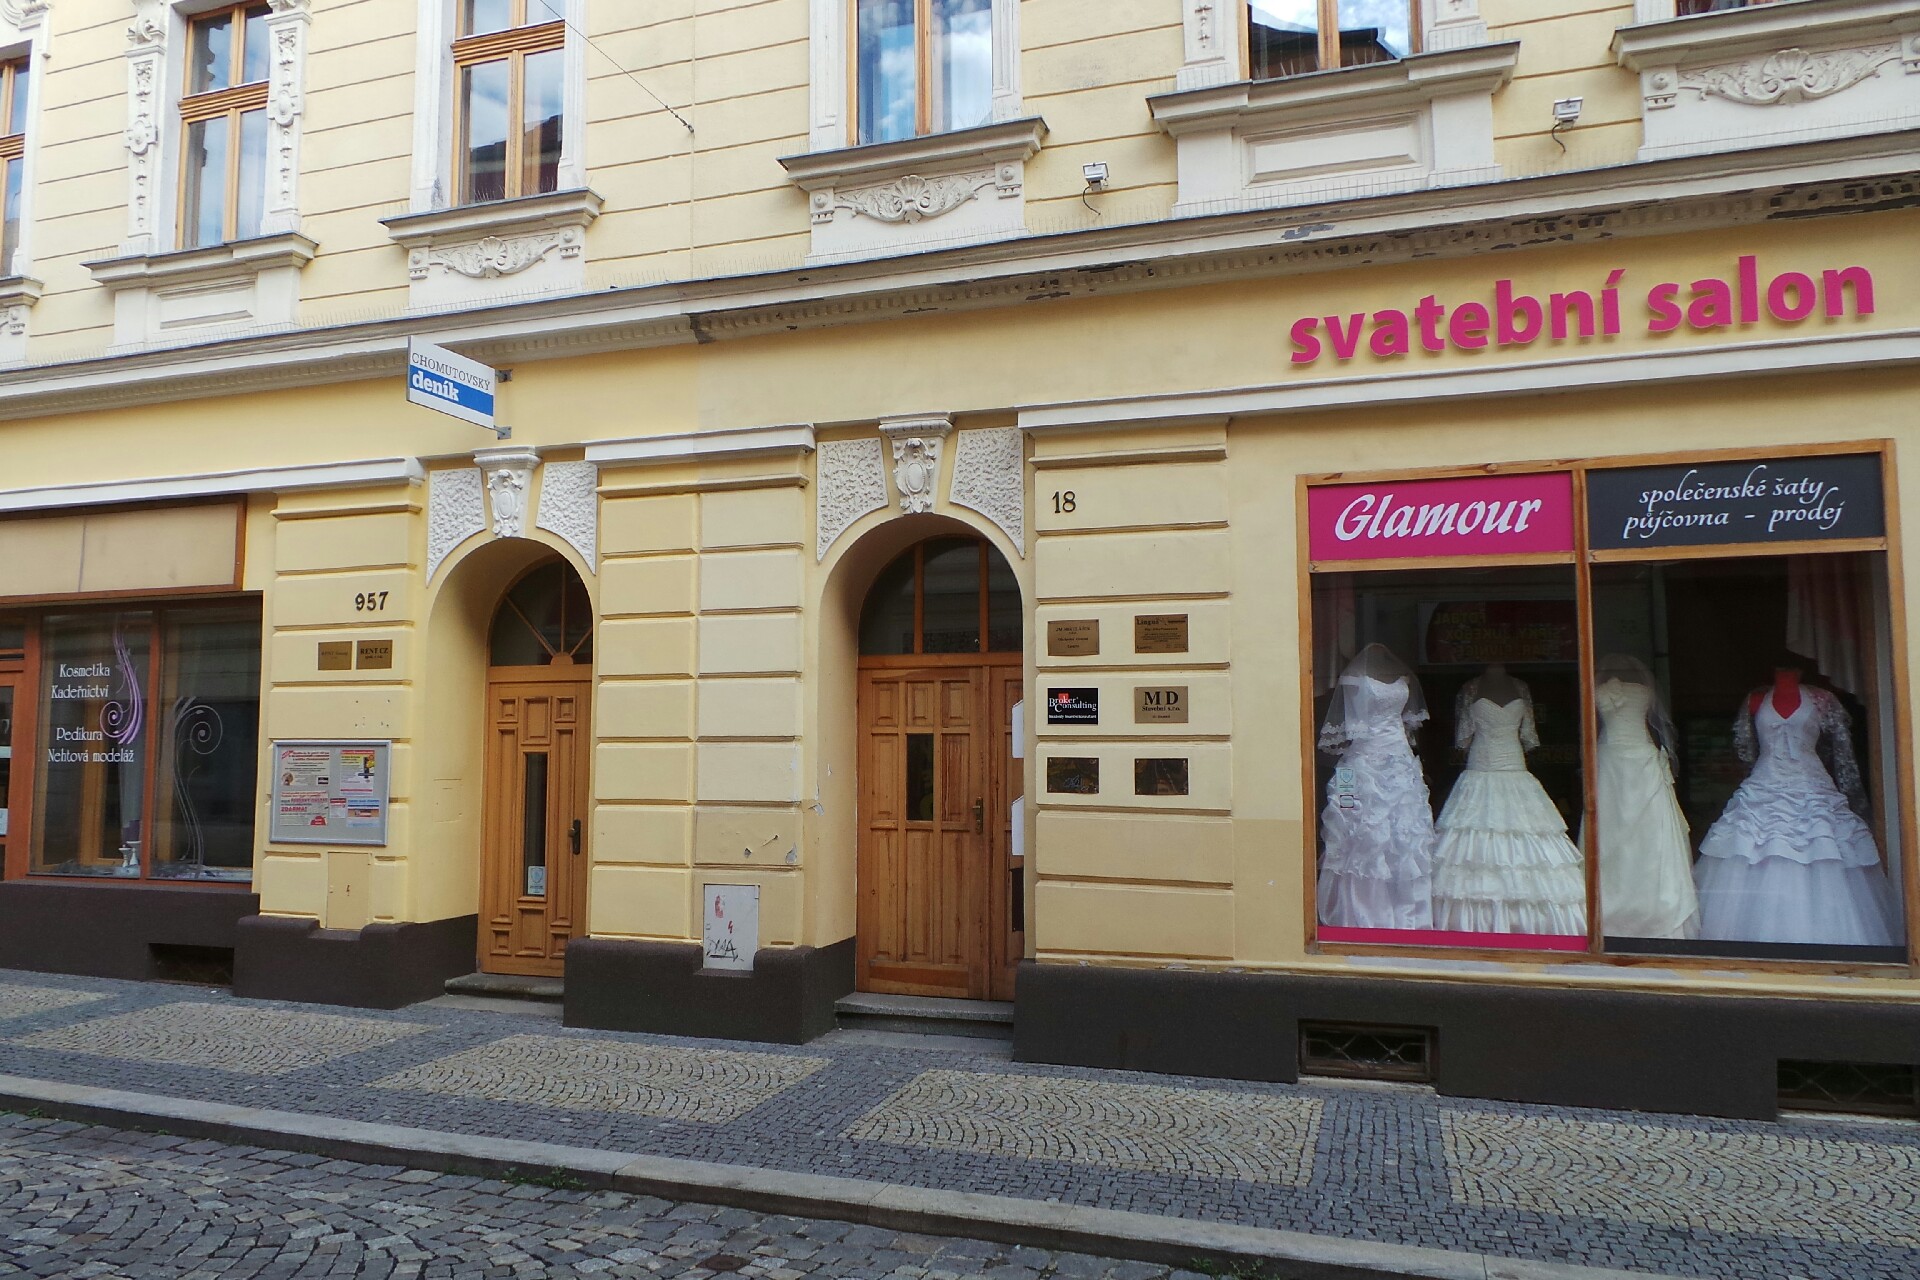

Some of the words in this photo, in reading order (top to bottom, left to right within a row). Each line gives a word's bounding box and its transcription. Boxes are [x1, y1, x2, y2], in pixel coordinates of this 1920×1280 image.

[1289, 268, 1626, 364] svatební
[1647, 254, 1875, 333] salon
[411, 352, 491, 391] CHOMUTOVSKÝ
[412, 370, 460, 402] deník
[1639, 464, 1768, 512] společenské
[1772, 476, 1824, 504] šaty
[1052, 491, 1076, 513] 18
[1622, 508, 1729, 539] půjčovna
[1767, 486, 1847, 533] prodej
[1334, 493, 1542, 541] Glamour
[355, 591, 388, 611] 957
[59, 663, 110, 677] Kosmetika
[51, 684, 109, 699] Kadeřnictví
[1049, 696, 1076, 707] Broker
[1054, 701, 1097, 712] Consulting
[56, 726, 103, 741] Pedikura
[47, 748, 89, 762] Nehtová
[92, 748, 134, 762] modeláž
